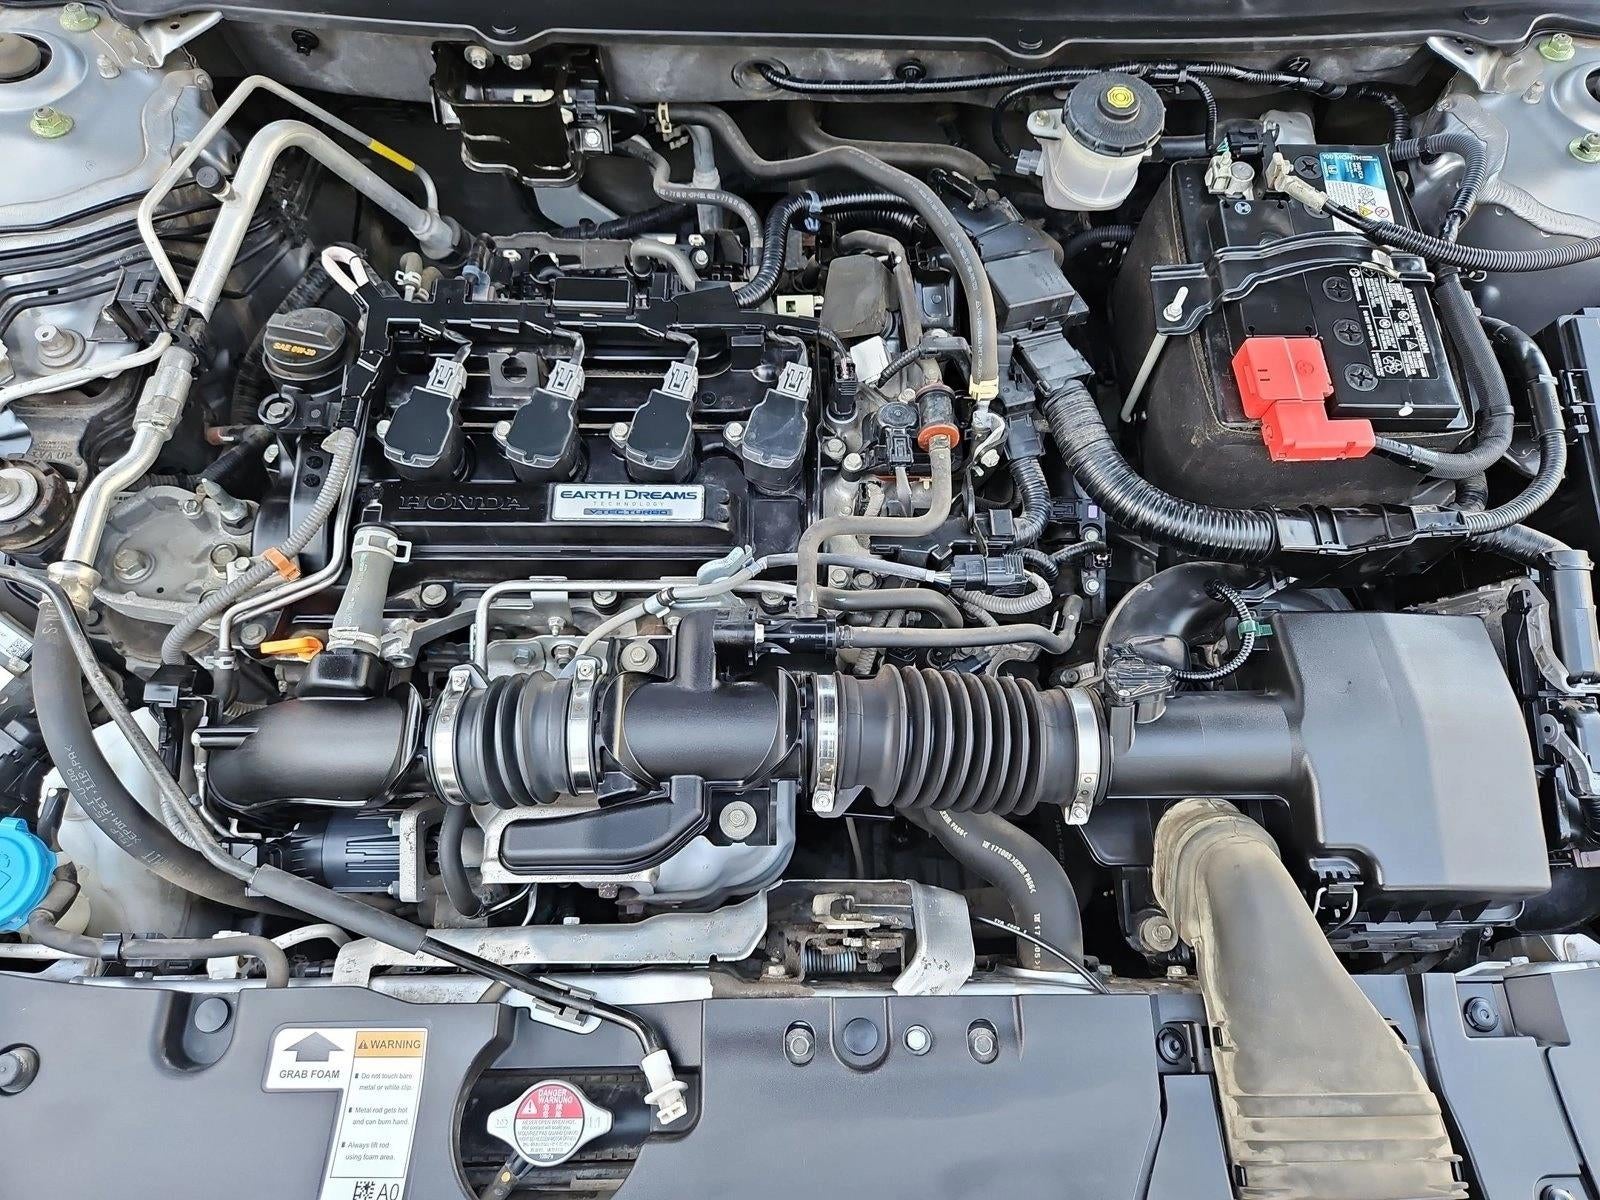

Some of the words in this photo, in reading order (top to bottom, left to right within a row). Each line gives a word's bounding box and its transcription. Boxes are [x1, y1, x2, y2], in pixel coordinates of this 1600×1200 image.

[272, 342, 292, 352] SAE
[560, 490, 620, 500] EARTH
[624, 489, 698, 500] DREAMS
[399, 492, 530, 511] HONDA
[370, 1039, 422, 1050] WARNING
[279, 1069, 308, 1079] GRAB
[310, 1069, 341, 1079] FOAM
[359, 1083, 376, 1091] metal
[384, 1083, 399, 1091] white
[376, 1183, 400, 1200] A0
